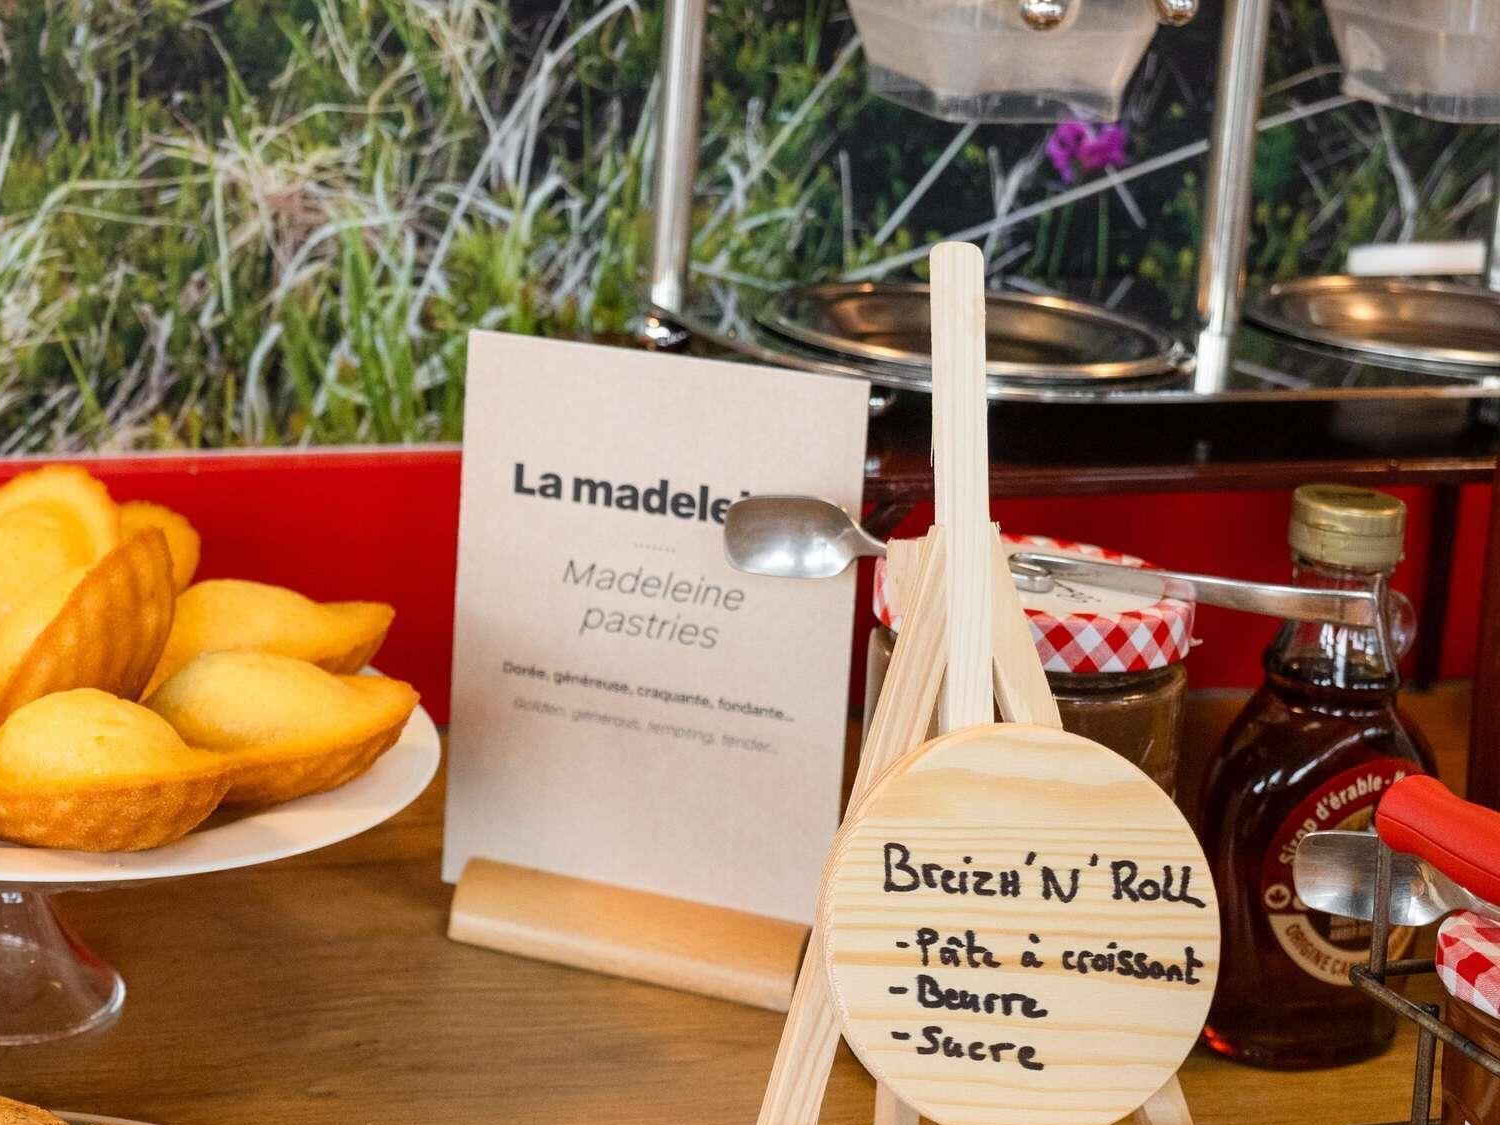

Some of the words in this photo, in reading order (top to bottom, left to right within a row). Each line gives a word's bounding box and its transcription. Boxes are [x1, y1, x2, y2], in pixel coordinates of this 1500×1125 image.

[513, 463, 563, 499] La
[572, 476, 750, 525] madele
[561, 559, 746, 613] Madeleine
[579, 606, 720, 651] pastries
[553, 671, 633, 696] généreuse,
[1316, 773, 1382, 821] d'érable
[1020, 933, 1044, 970] à
[1062, 942, 1205, 985] croissant
